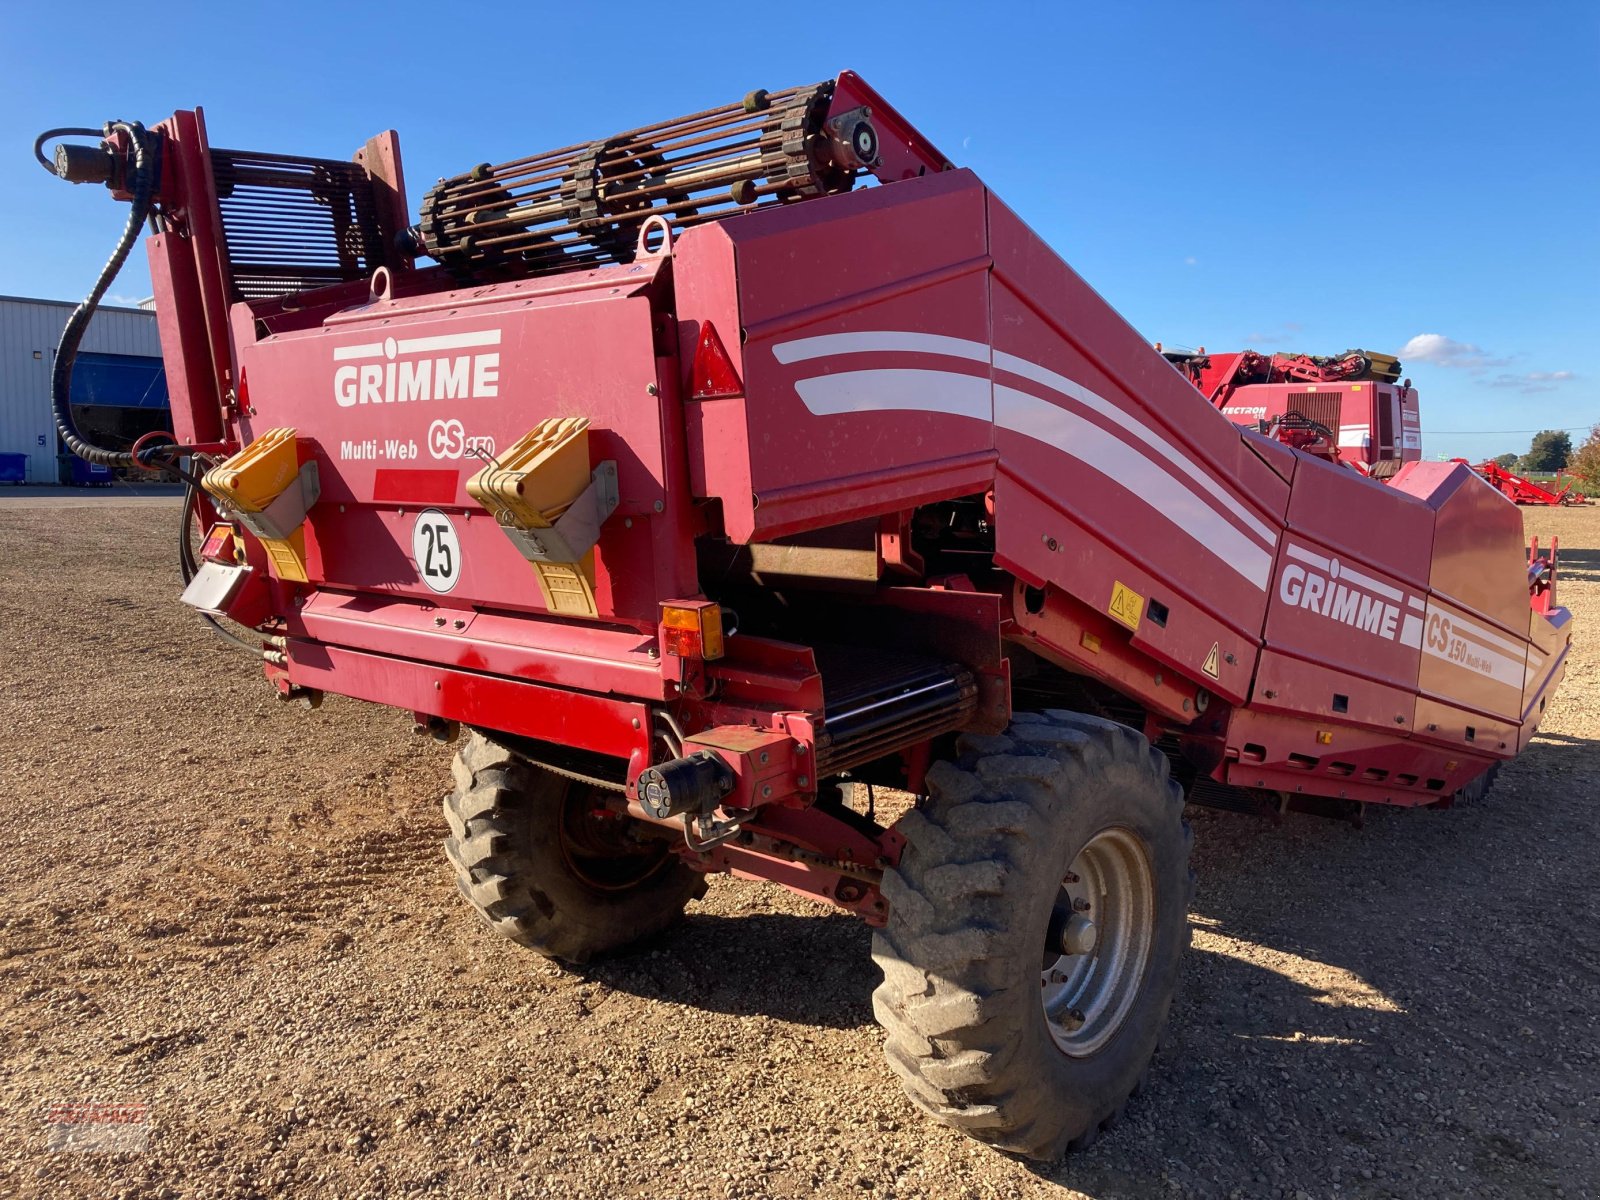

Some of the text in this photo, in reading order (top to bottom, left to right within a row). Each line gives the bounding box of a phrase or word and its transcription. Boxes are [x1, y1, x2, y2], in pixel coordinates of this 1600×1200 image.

[334, 337, 501, 407] GRIMME
[1222, 406, 1267, 415] TECTRON
[38, 435, 46, 446] 5
[340, 438, 418, 461] Multi-Web
[428, 418, 465, 460] CS
[420, 522, 453, 579] 25
[1279, 557, 1400, 641] GRIMME
[1427, 612, 1451, 653] CS
[1447, 638, 1467, 663] 150
